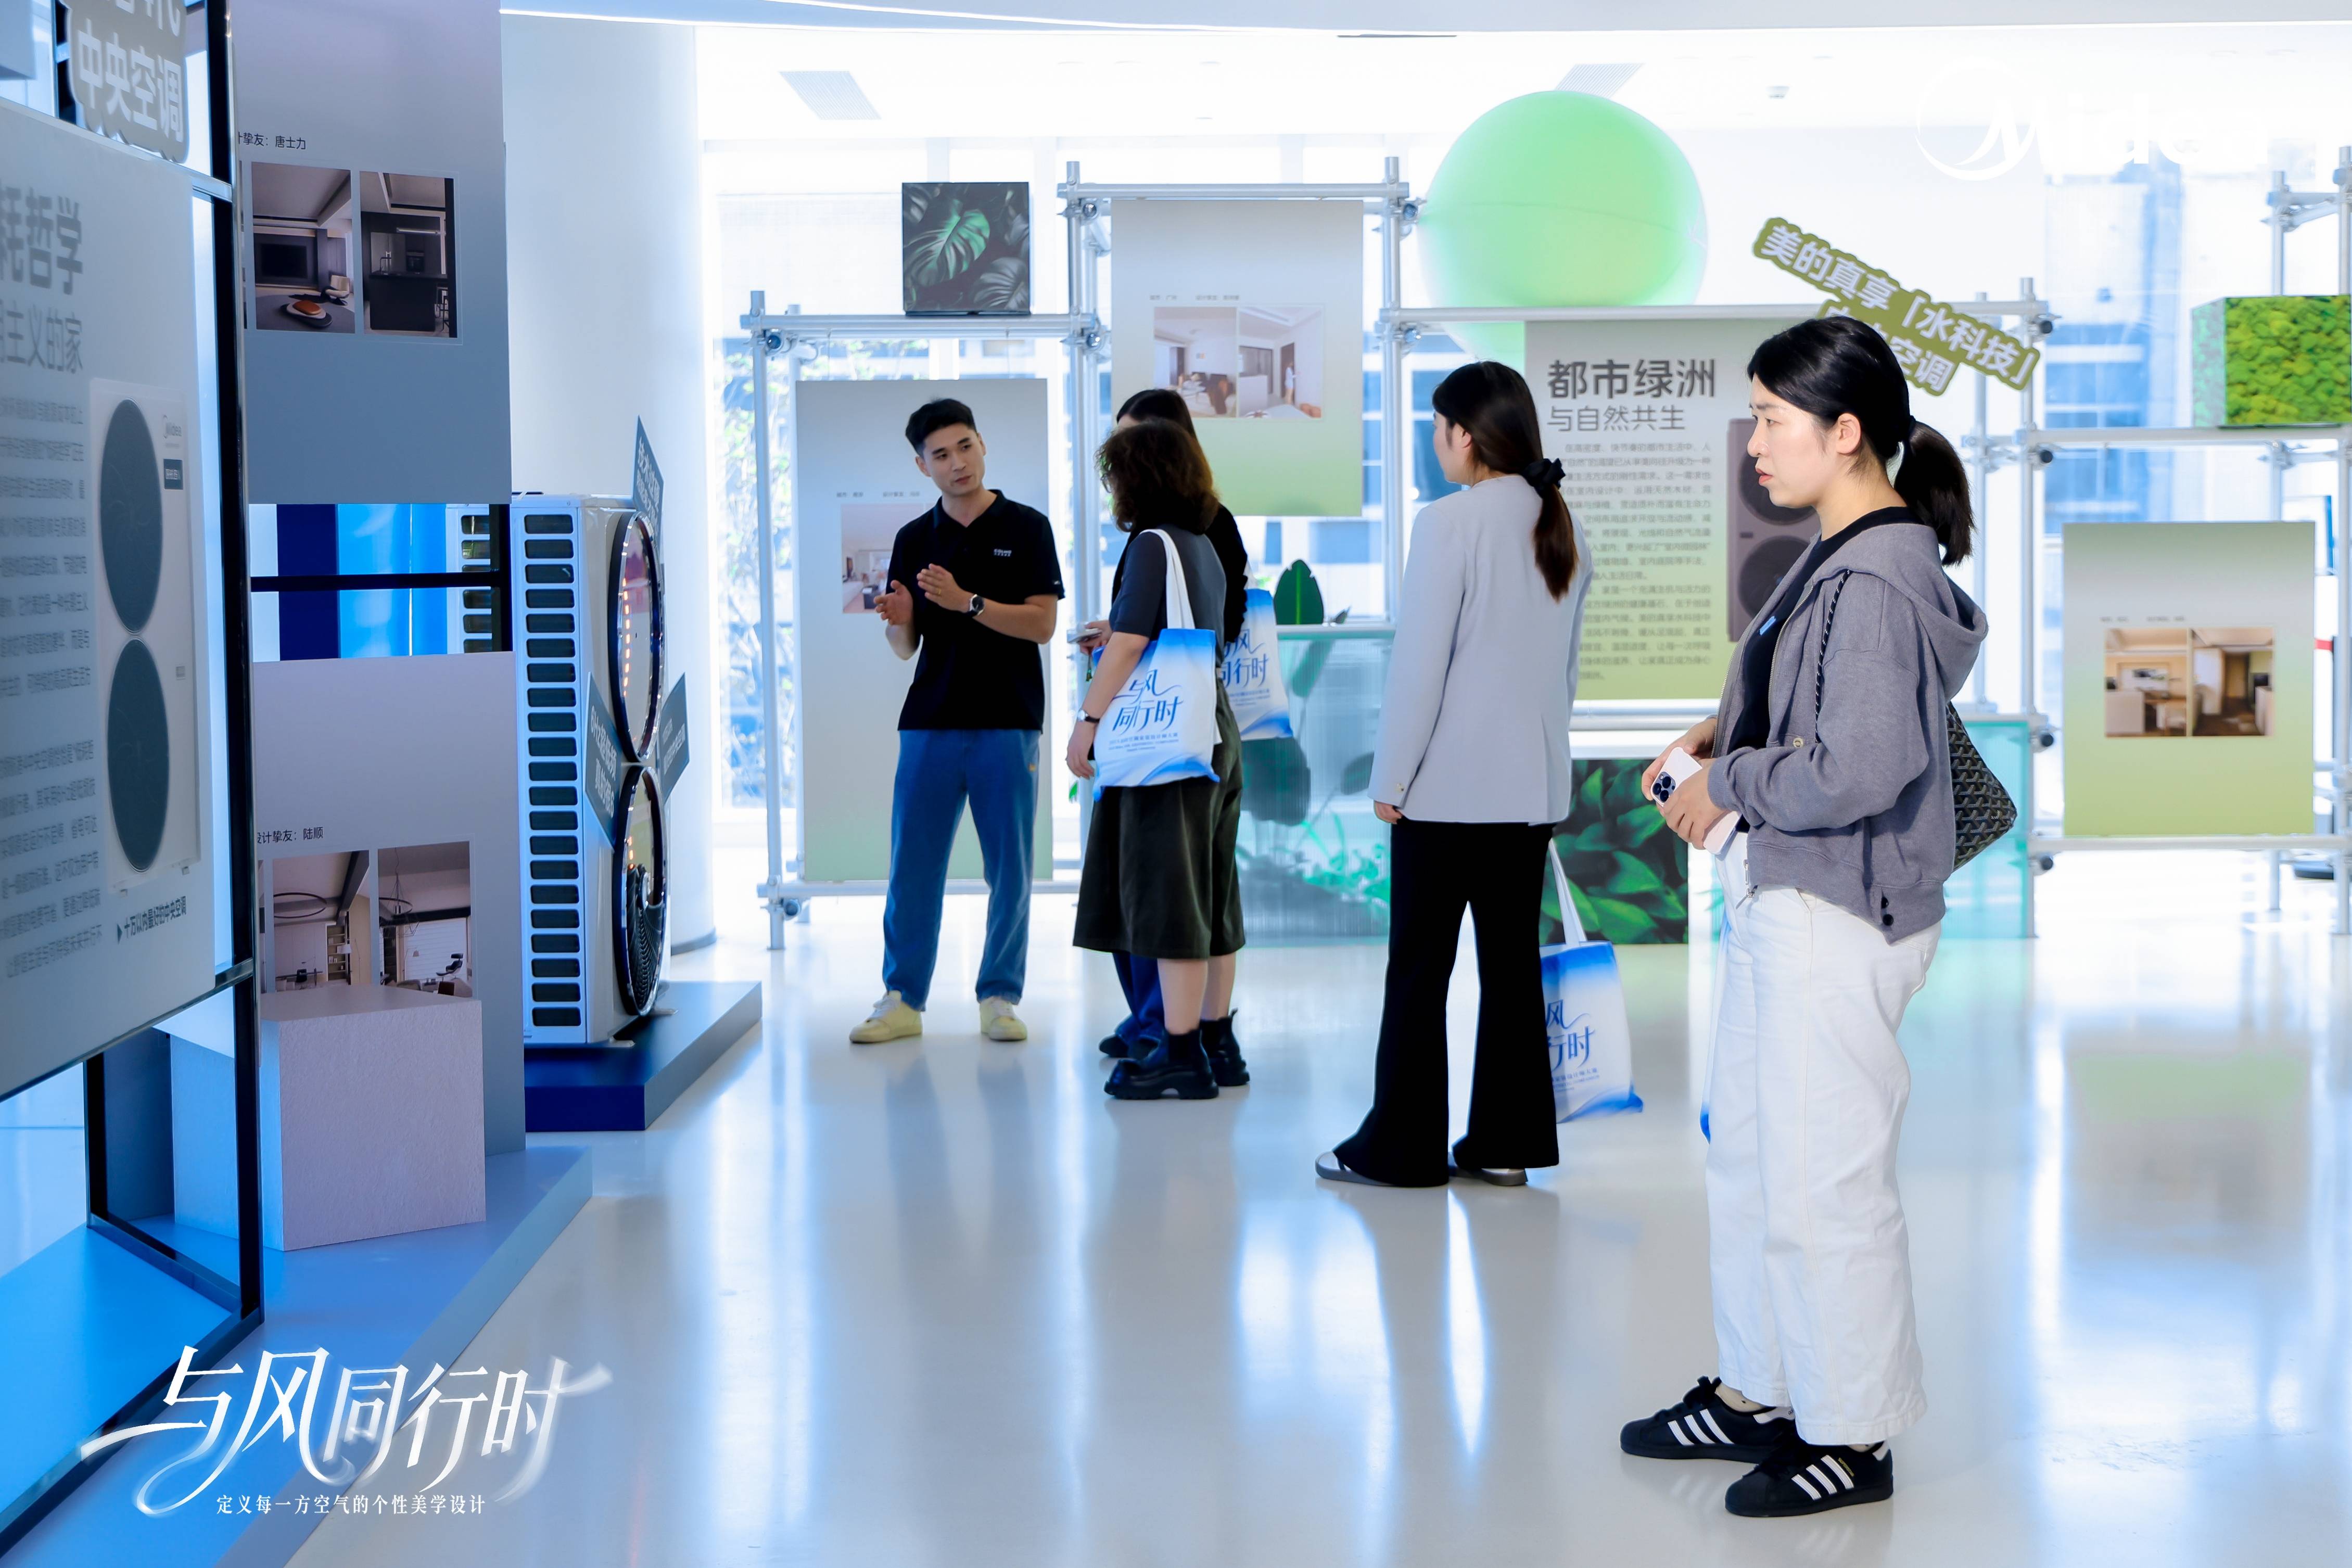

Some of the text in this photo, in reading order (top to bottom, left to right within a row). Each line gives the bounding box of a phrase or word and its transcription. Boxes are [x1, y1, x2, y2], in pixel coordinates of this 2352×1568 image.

[77, 17, 183, 143] 中央空调
[1761, 225, 2037, 385] 美的真享「水科技」
[0, 298, 83, 375] 主义的家
[1823, 305, 1955, 393] 空调
[1547, 359, 1715, 399] 都市绿洲
[1546, 405, 1685, 431] 与自然共生
[1112, 669, 1182, 705] 与风
[1112, 696, 1184, 736] 同行时
